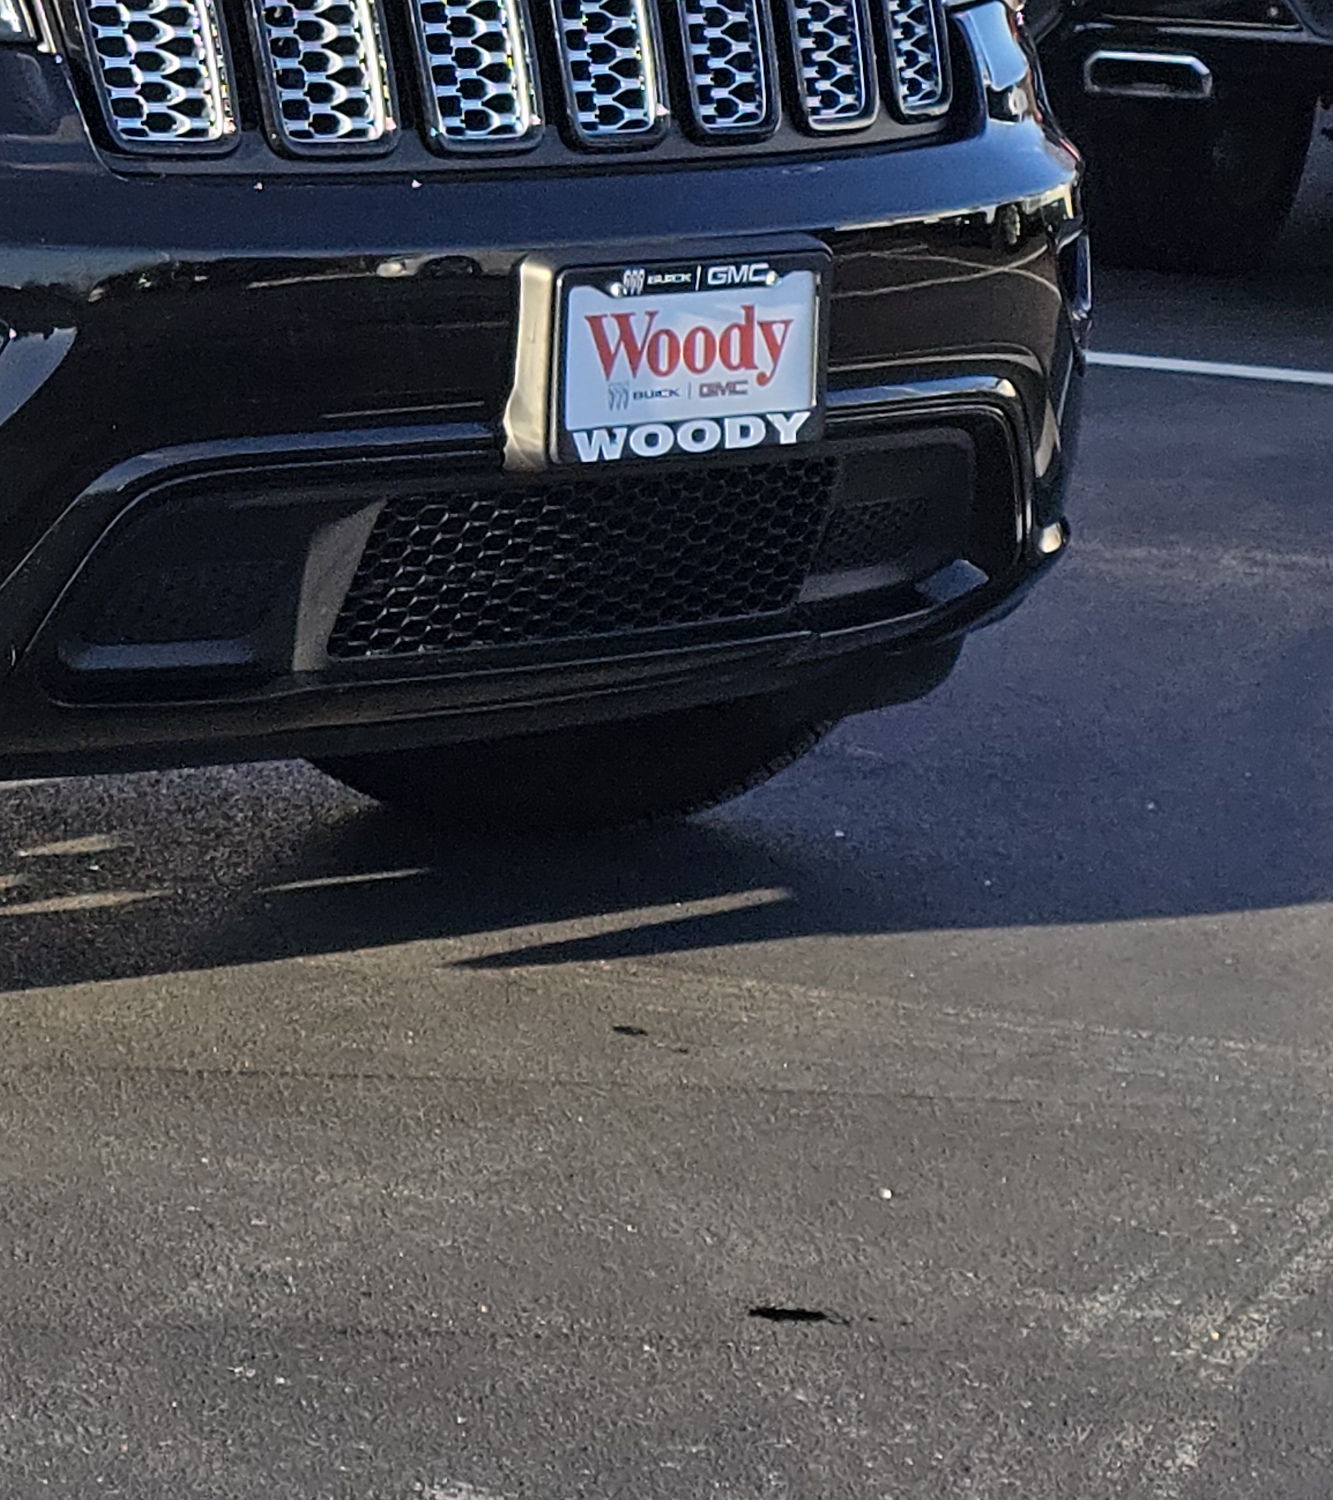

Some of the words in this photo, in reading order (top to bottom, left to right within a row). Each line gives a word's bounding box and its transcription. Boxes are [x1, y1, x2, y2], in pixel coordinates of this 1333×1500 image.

[646, 272, 693, 285] BUICK
[707, 262, 770, 286] GMC
[585, 304, 793, 386] Woody
[633, 387, 681, 400] BUICK
[699, 379, 749, 399] GMC
[572, 411, 811, 463] WOODY
